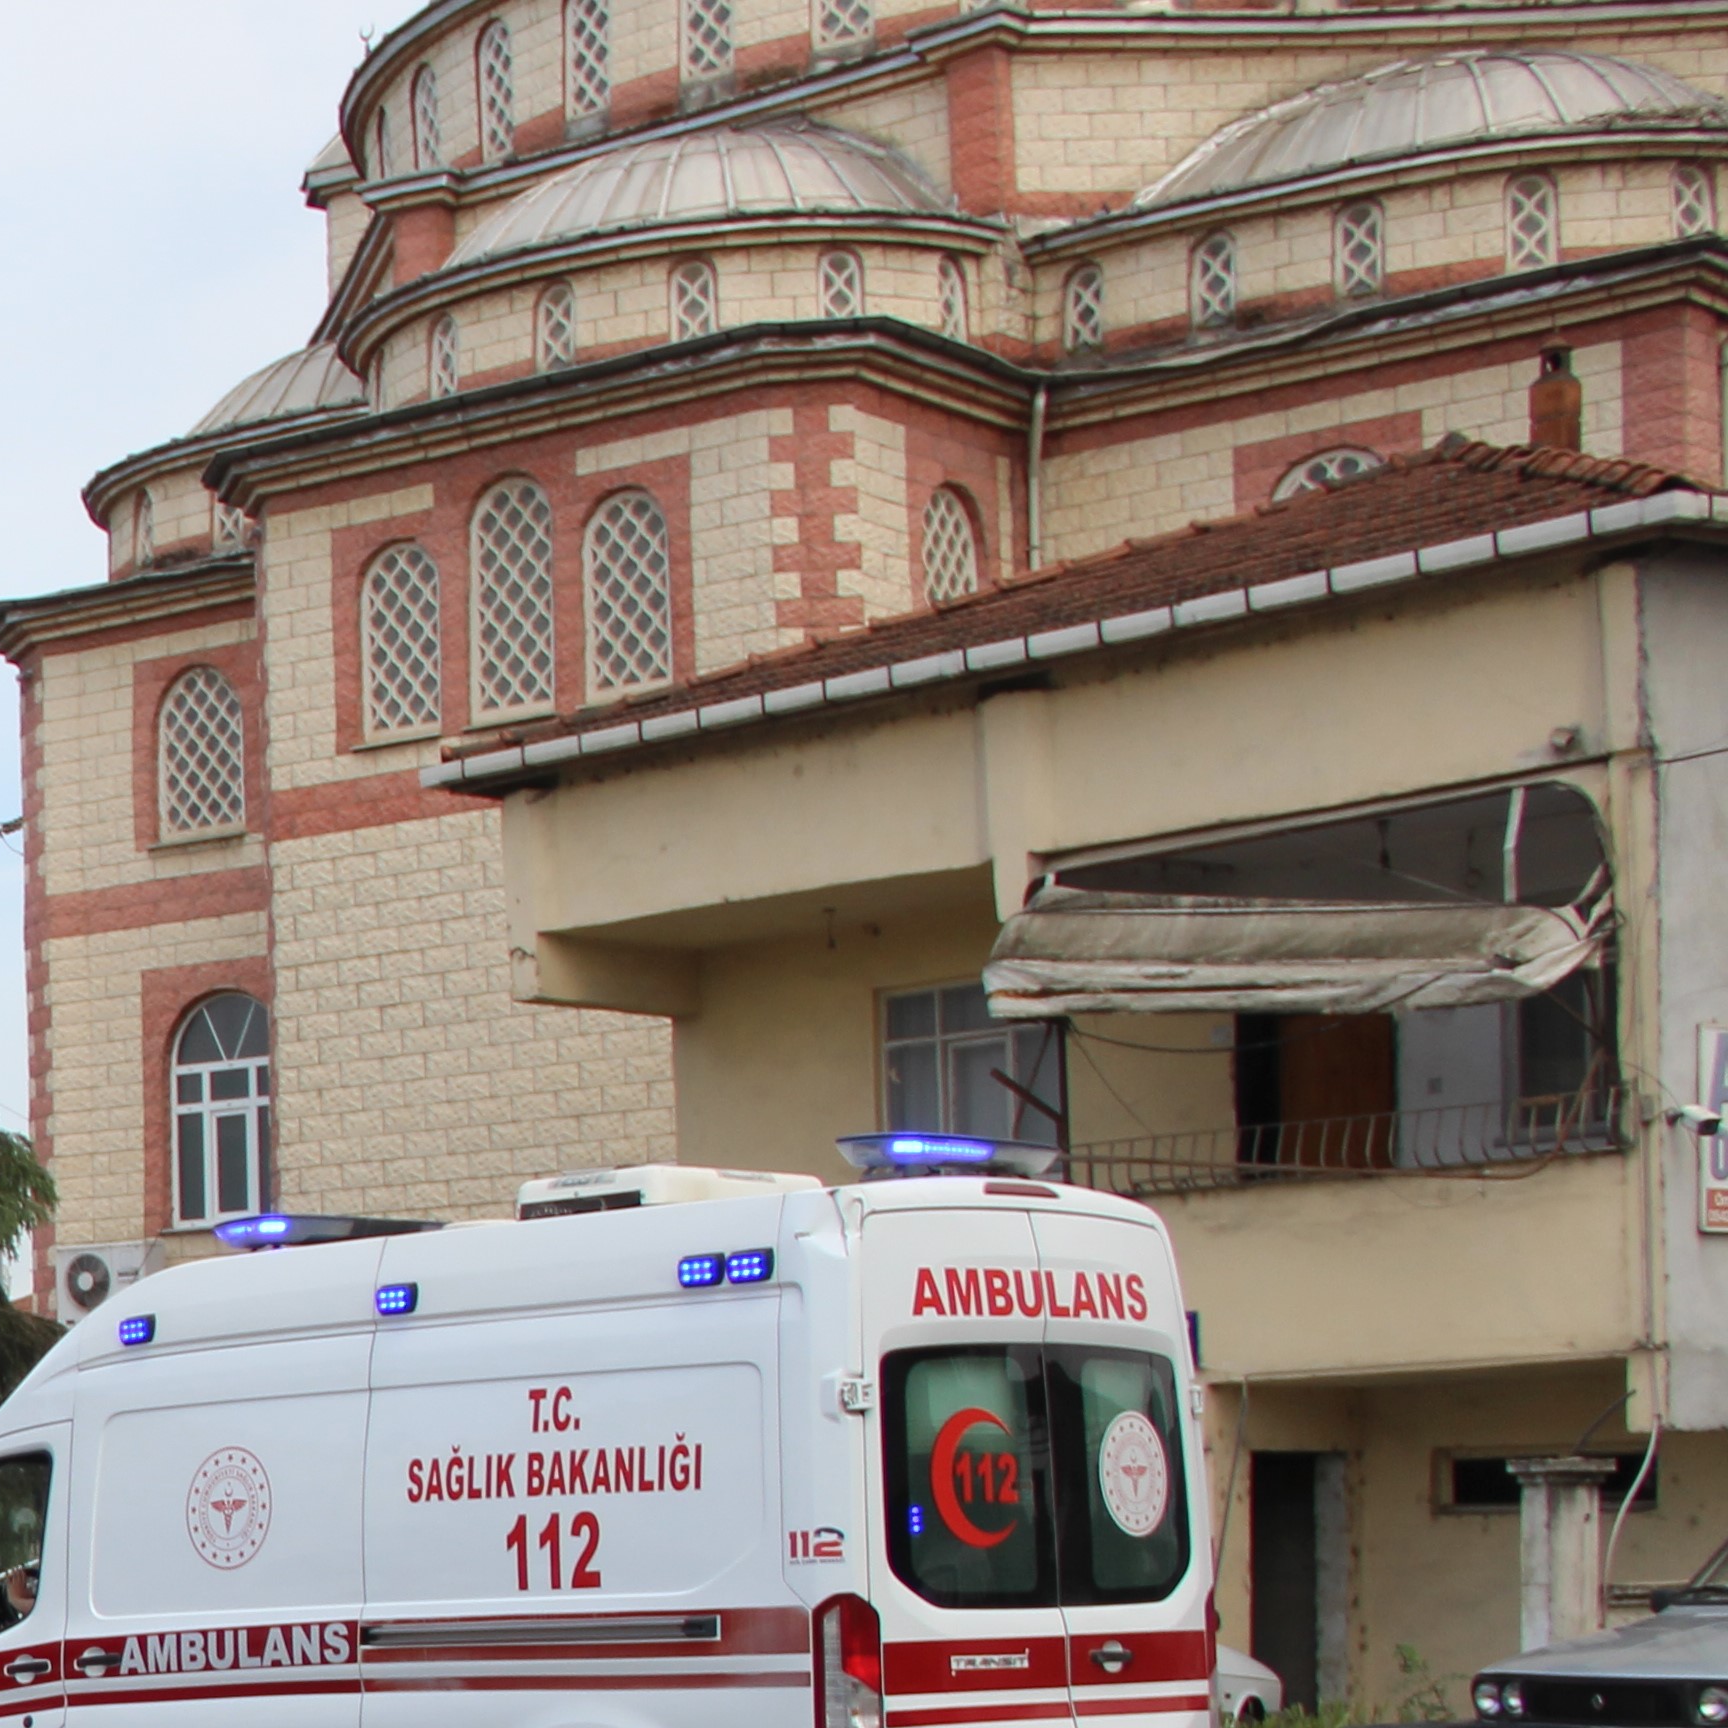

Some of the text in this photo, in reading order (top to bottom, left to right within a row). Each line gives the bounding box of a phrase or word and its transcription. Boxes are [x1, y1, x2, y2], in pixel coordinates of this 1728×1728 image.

[912, 1267, 1148, 1321] AMBULANS
[529, 1386, 580, 1434] T.C.
[407, 1433, 703, 1502] SAĞLIK BAKANLIĞI
[955, 1451, 1021, 1504] 112
[506, 1511, 602, 1591] 112
[788, 1527, 845, 1559] 112
[120, 1622, 351, 1675] AMBULANS
[952, 1655, 1028, 1669] TRANSIT
